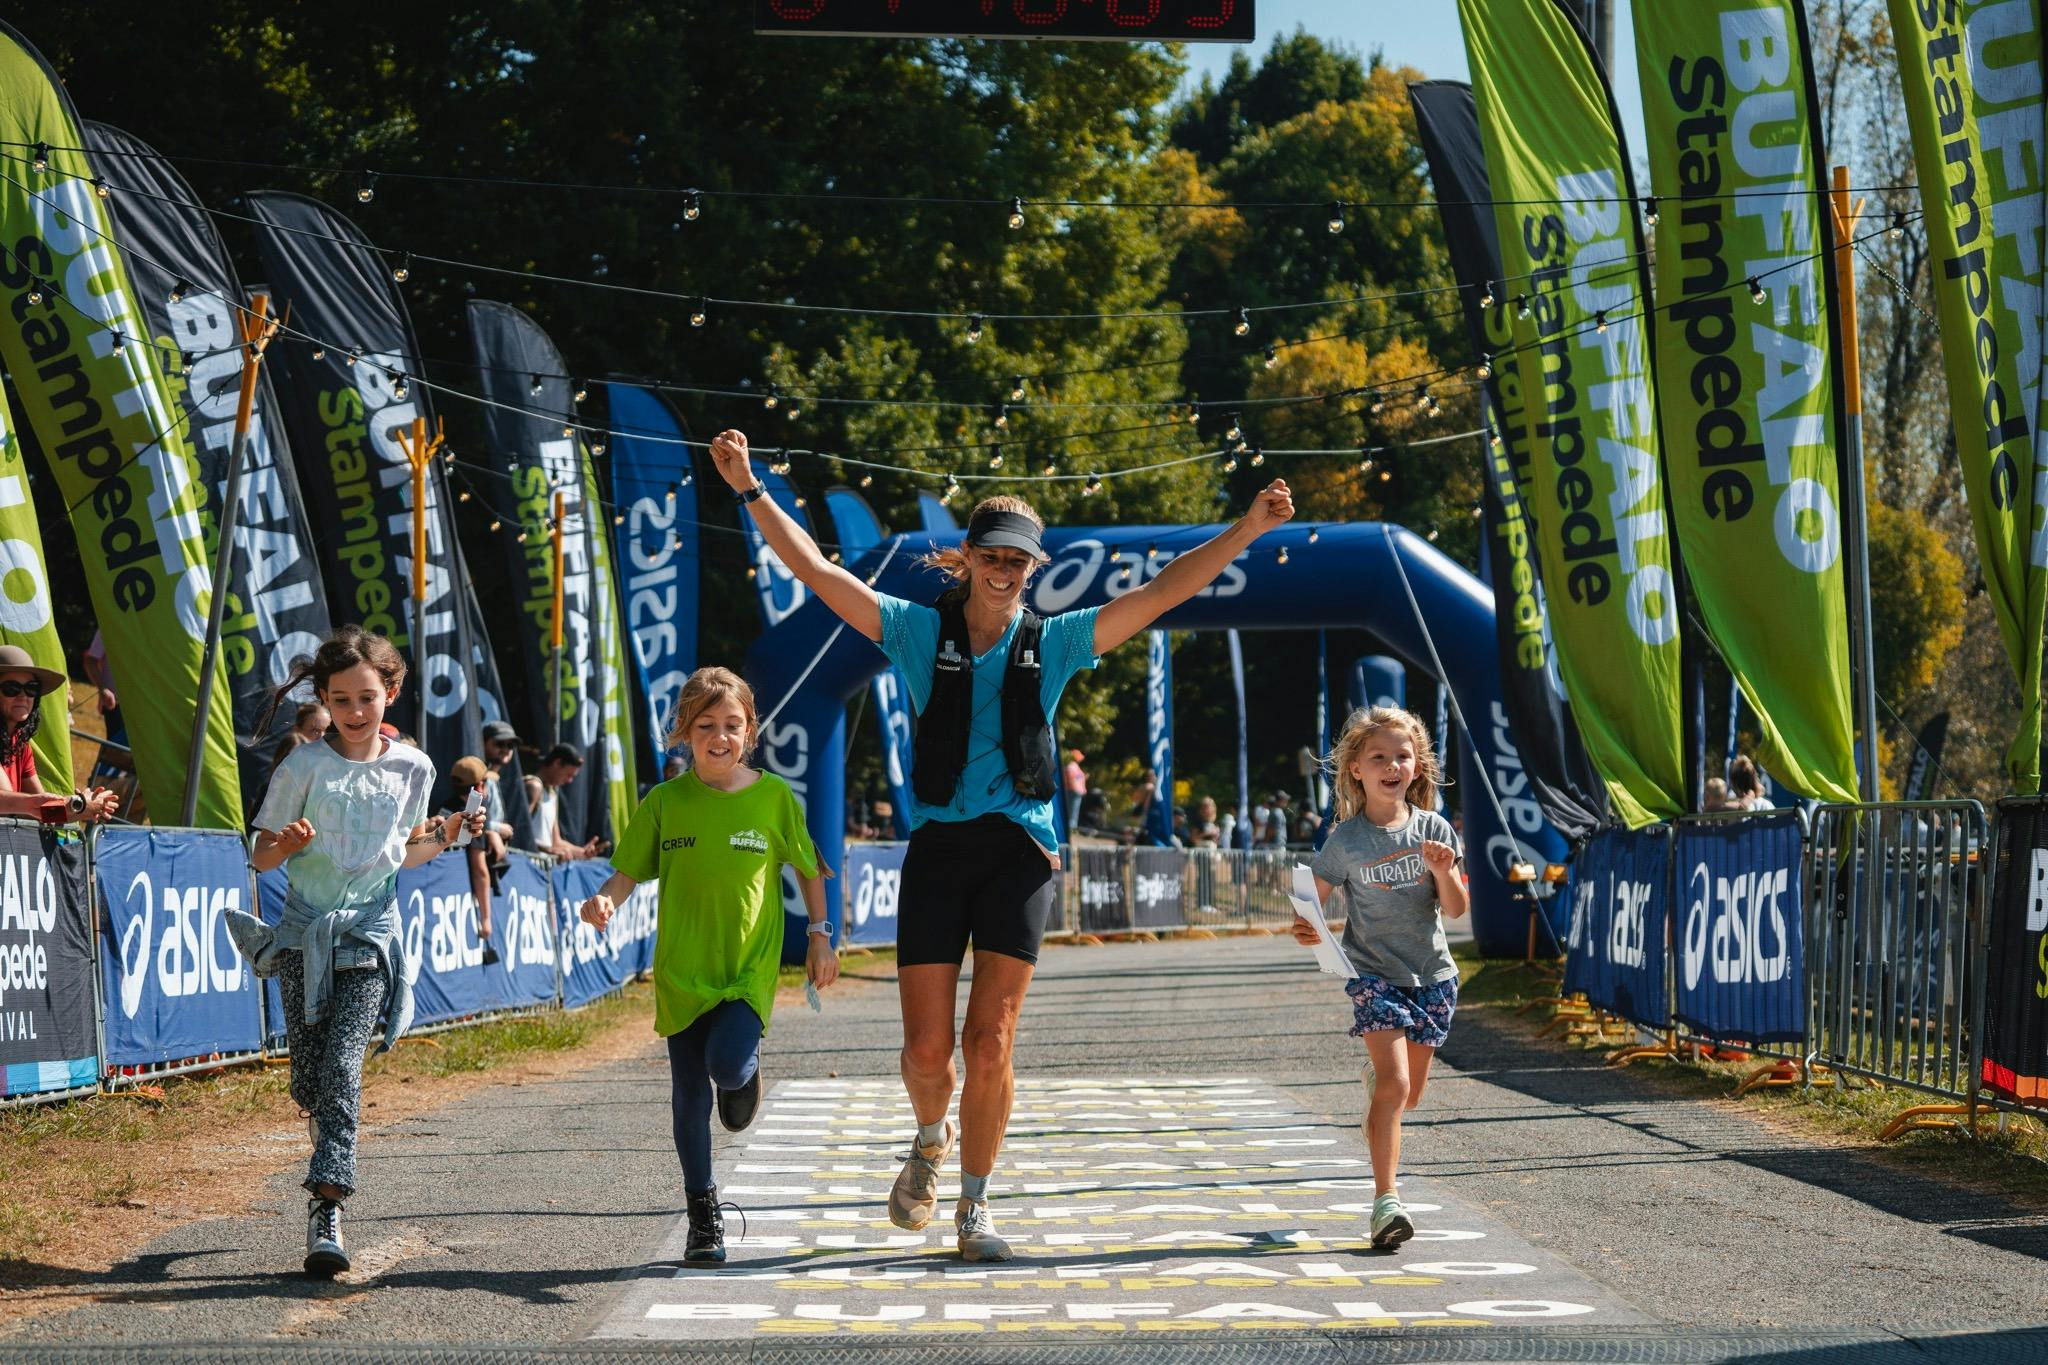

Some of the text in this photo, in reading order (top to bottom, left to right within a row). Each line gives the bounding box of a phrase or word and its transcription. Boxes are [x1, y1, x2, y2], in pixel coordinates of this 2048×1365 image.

[1668, 55, 1767, 522] Stampede
[1719, 5, 1841, 573] BUFFALO
[0, 236, 155, 613] Stampede
[1523, 213, 1618, 606] Stampede
[1556, 168, 1679, 645] BUFFALO
[318, 387, 408, 648] Stamped
[662, 837, 696, 851] CREW
[729, 837, 768, 849] BUFFALO
[158, 887, 242, 997] asics
[1713, 867, 1788, 984] asics
[645, 1301, 1596, 1320] BUFFALO
[673, 1262, 1539, 1280] BUFFALO
[756, 1317, 1492, 1333] Stampede
[775, 1276, 1444, 1290] Stampede
